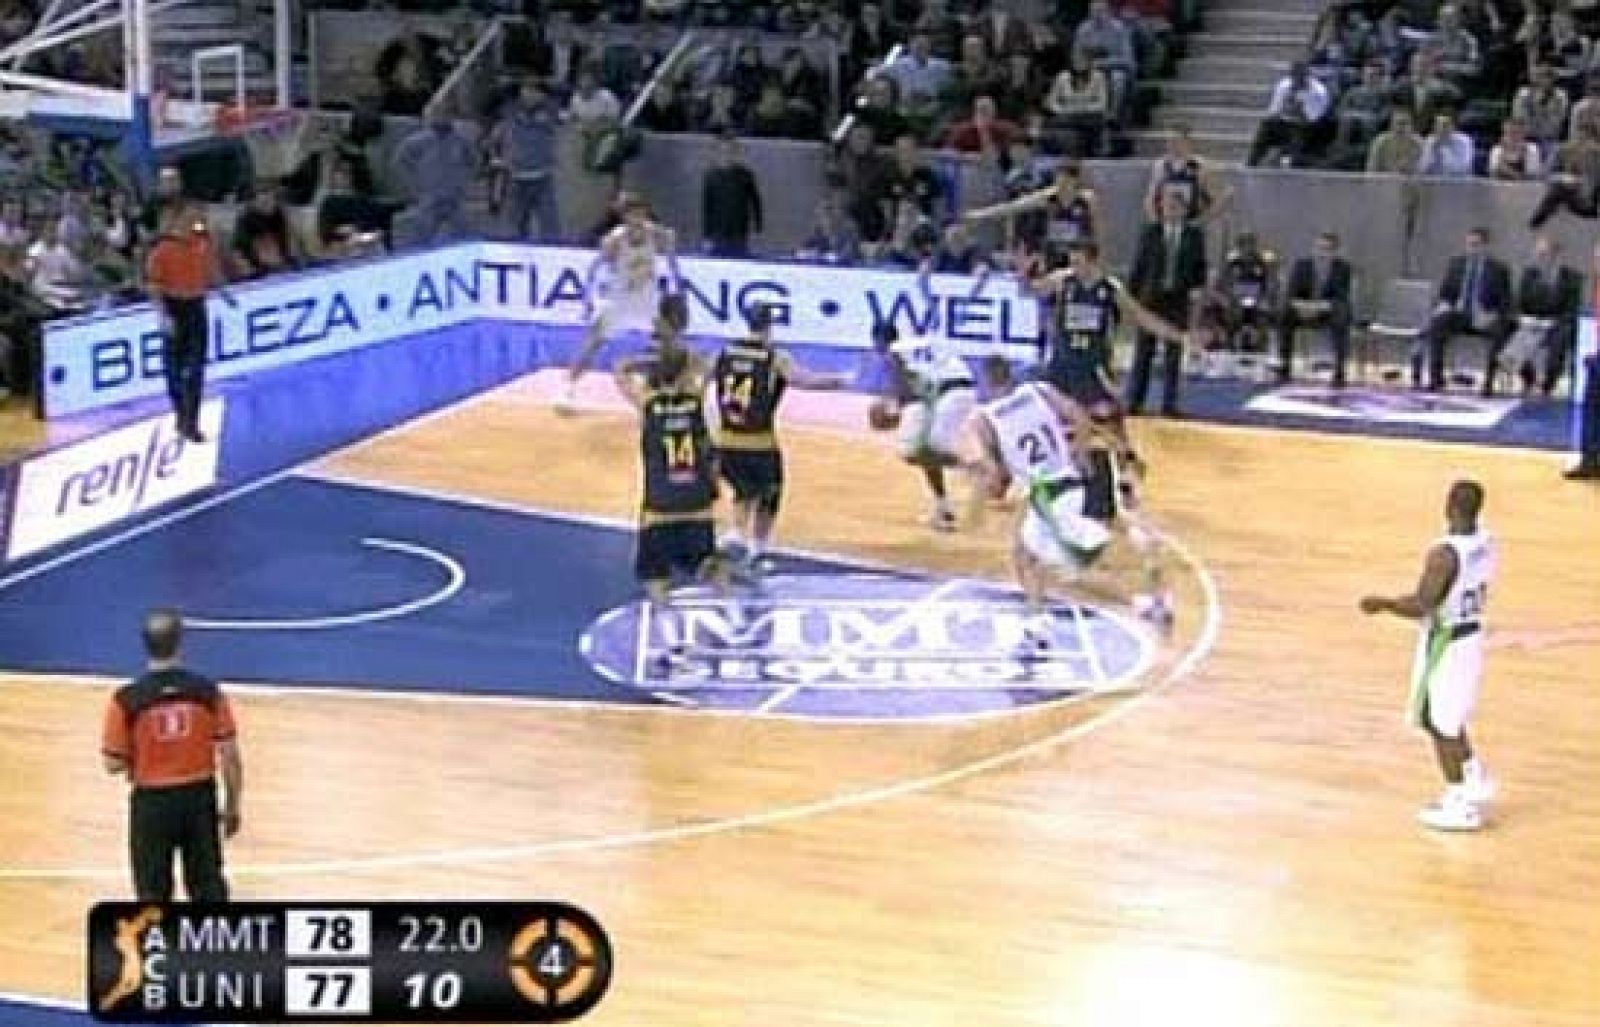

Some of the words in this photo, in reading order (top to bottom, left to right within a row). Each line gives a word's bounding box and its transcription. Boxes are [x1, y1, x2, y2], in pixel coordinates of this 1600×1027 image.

[91, 291, 360, 392] BELEZA
[407, 259, 792, 328] ANTIANG
[55, 424, 187, 516] renfe
[1016, 424, 1060, 465] 21
